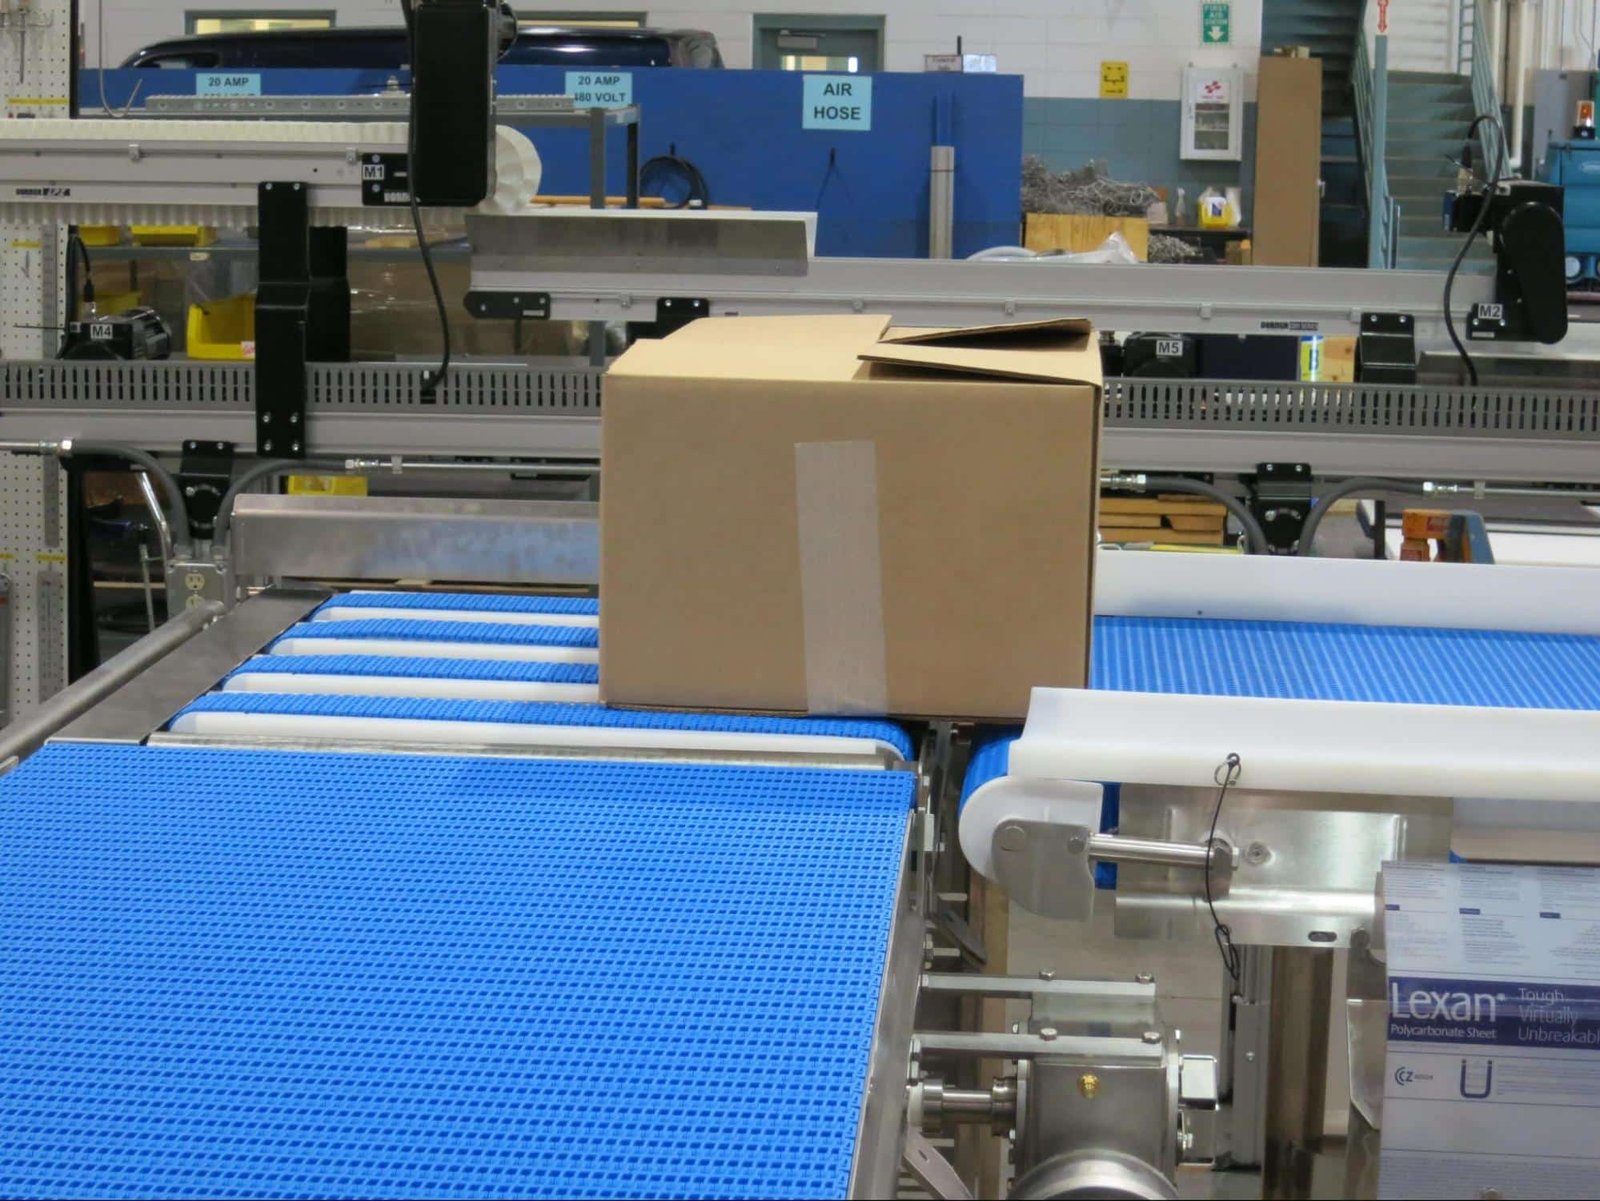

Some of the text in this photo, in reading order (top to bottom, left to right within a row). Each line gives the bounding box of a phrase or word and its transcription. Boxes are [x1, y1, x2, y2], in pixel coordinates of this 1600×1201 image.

[208, 76, 249, 87] 20 AMP
[577, 75, 620, 86] 20 AMP
[823, 83, 852, 96] AIR
[595, 92, 626, 102] VOLT
[814, 106, 861, 120] HOSE
[364, 166, 383, 178] M1
[1480, 304, 1501, 318] M2
[92, 326, 111, 338] M4
[1158, 341, 1179, 354] M5
[1391, 982, 1496, 1023] Lexan
[1519, 1004, 1578, 1028] Virtually
[1391, 1023, 1497, 1039] Polycarbonate Sheet
[1518, 1026, 1600, 1044] Unbreakabl
